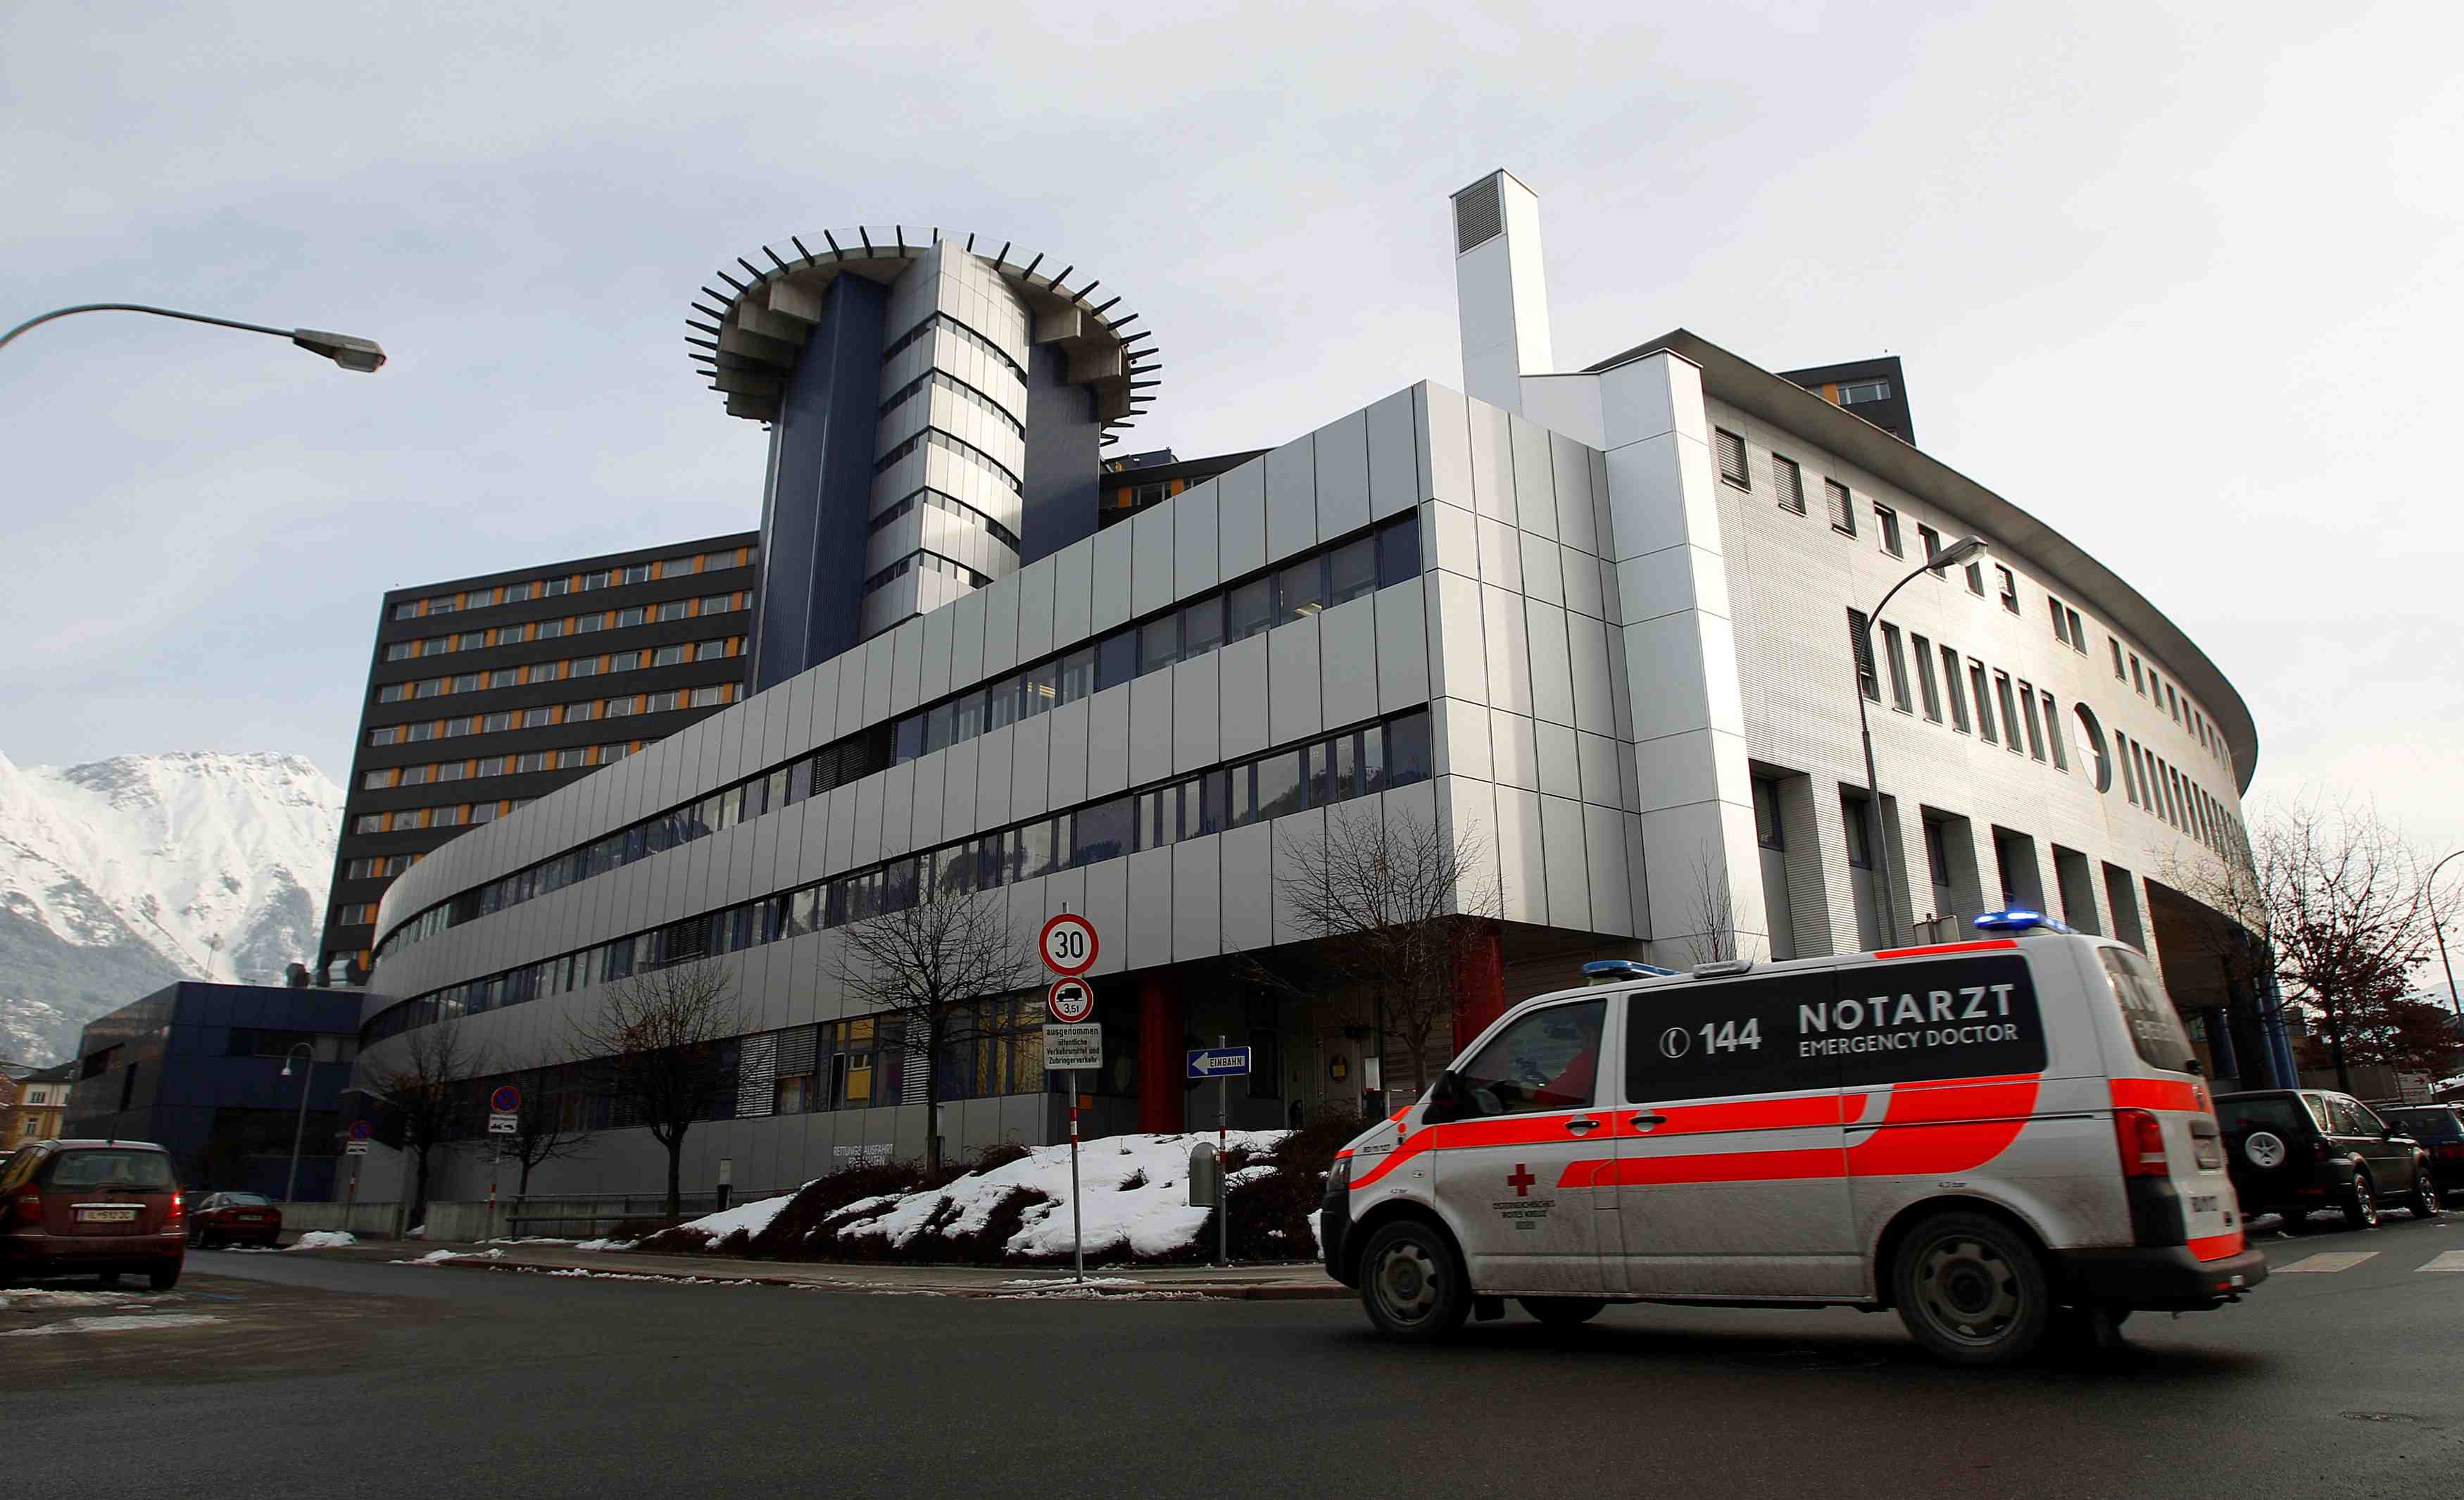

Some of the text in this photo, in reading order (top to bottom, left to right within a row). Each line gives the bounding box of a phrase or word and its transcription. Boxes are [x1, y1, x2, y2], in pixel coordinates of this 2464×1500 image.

[1054, 931, 1084, 958] 30
[1798, 984, 2014, 1034] NOTARZT
[1046, 1028, 1099, 1037] ausgenommen
[1698, 1018, 1763, 1055] 144
[1799, 1023, 2018, 1057] EMERGENCY DOCTOR
[1048, 1056, 1098, 1065] Zubringerverkehr
[1209, 1057, 1243, 1068] EINBAHN
